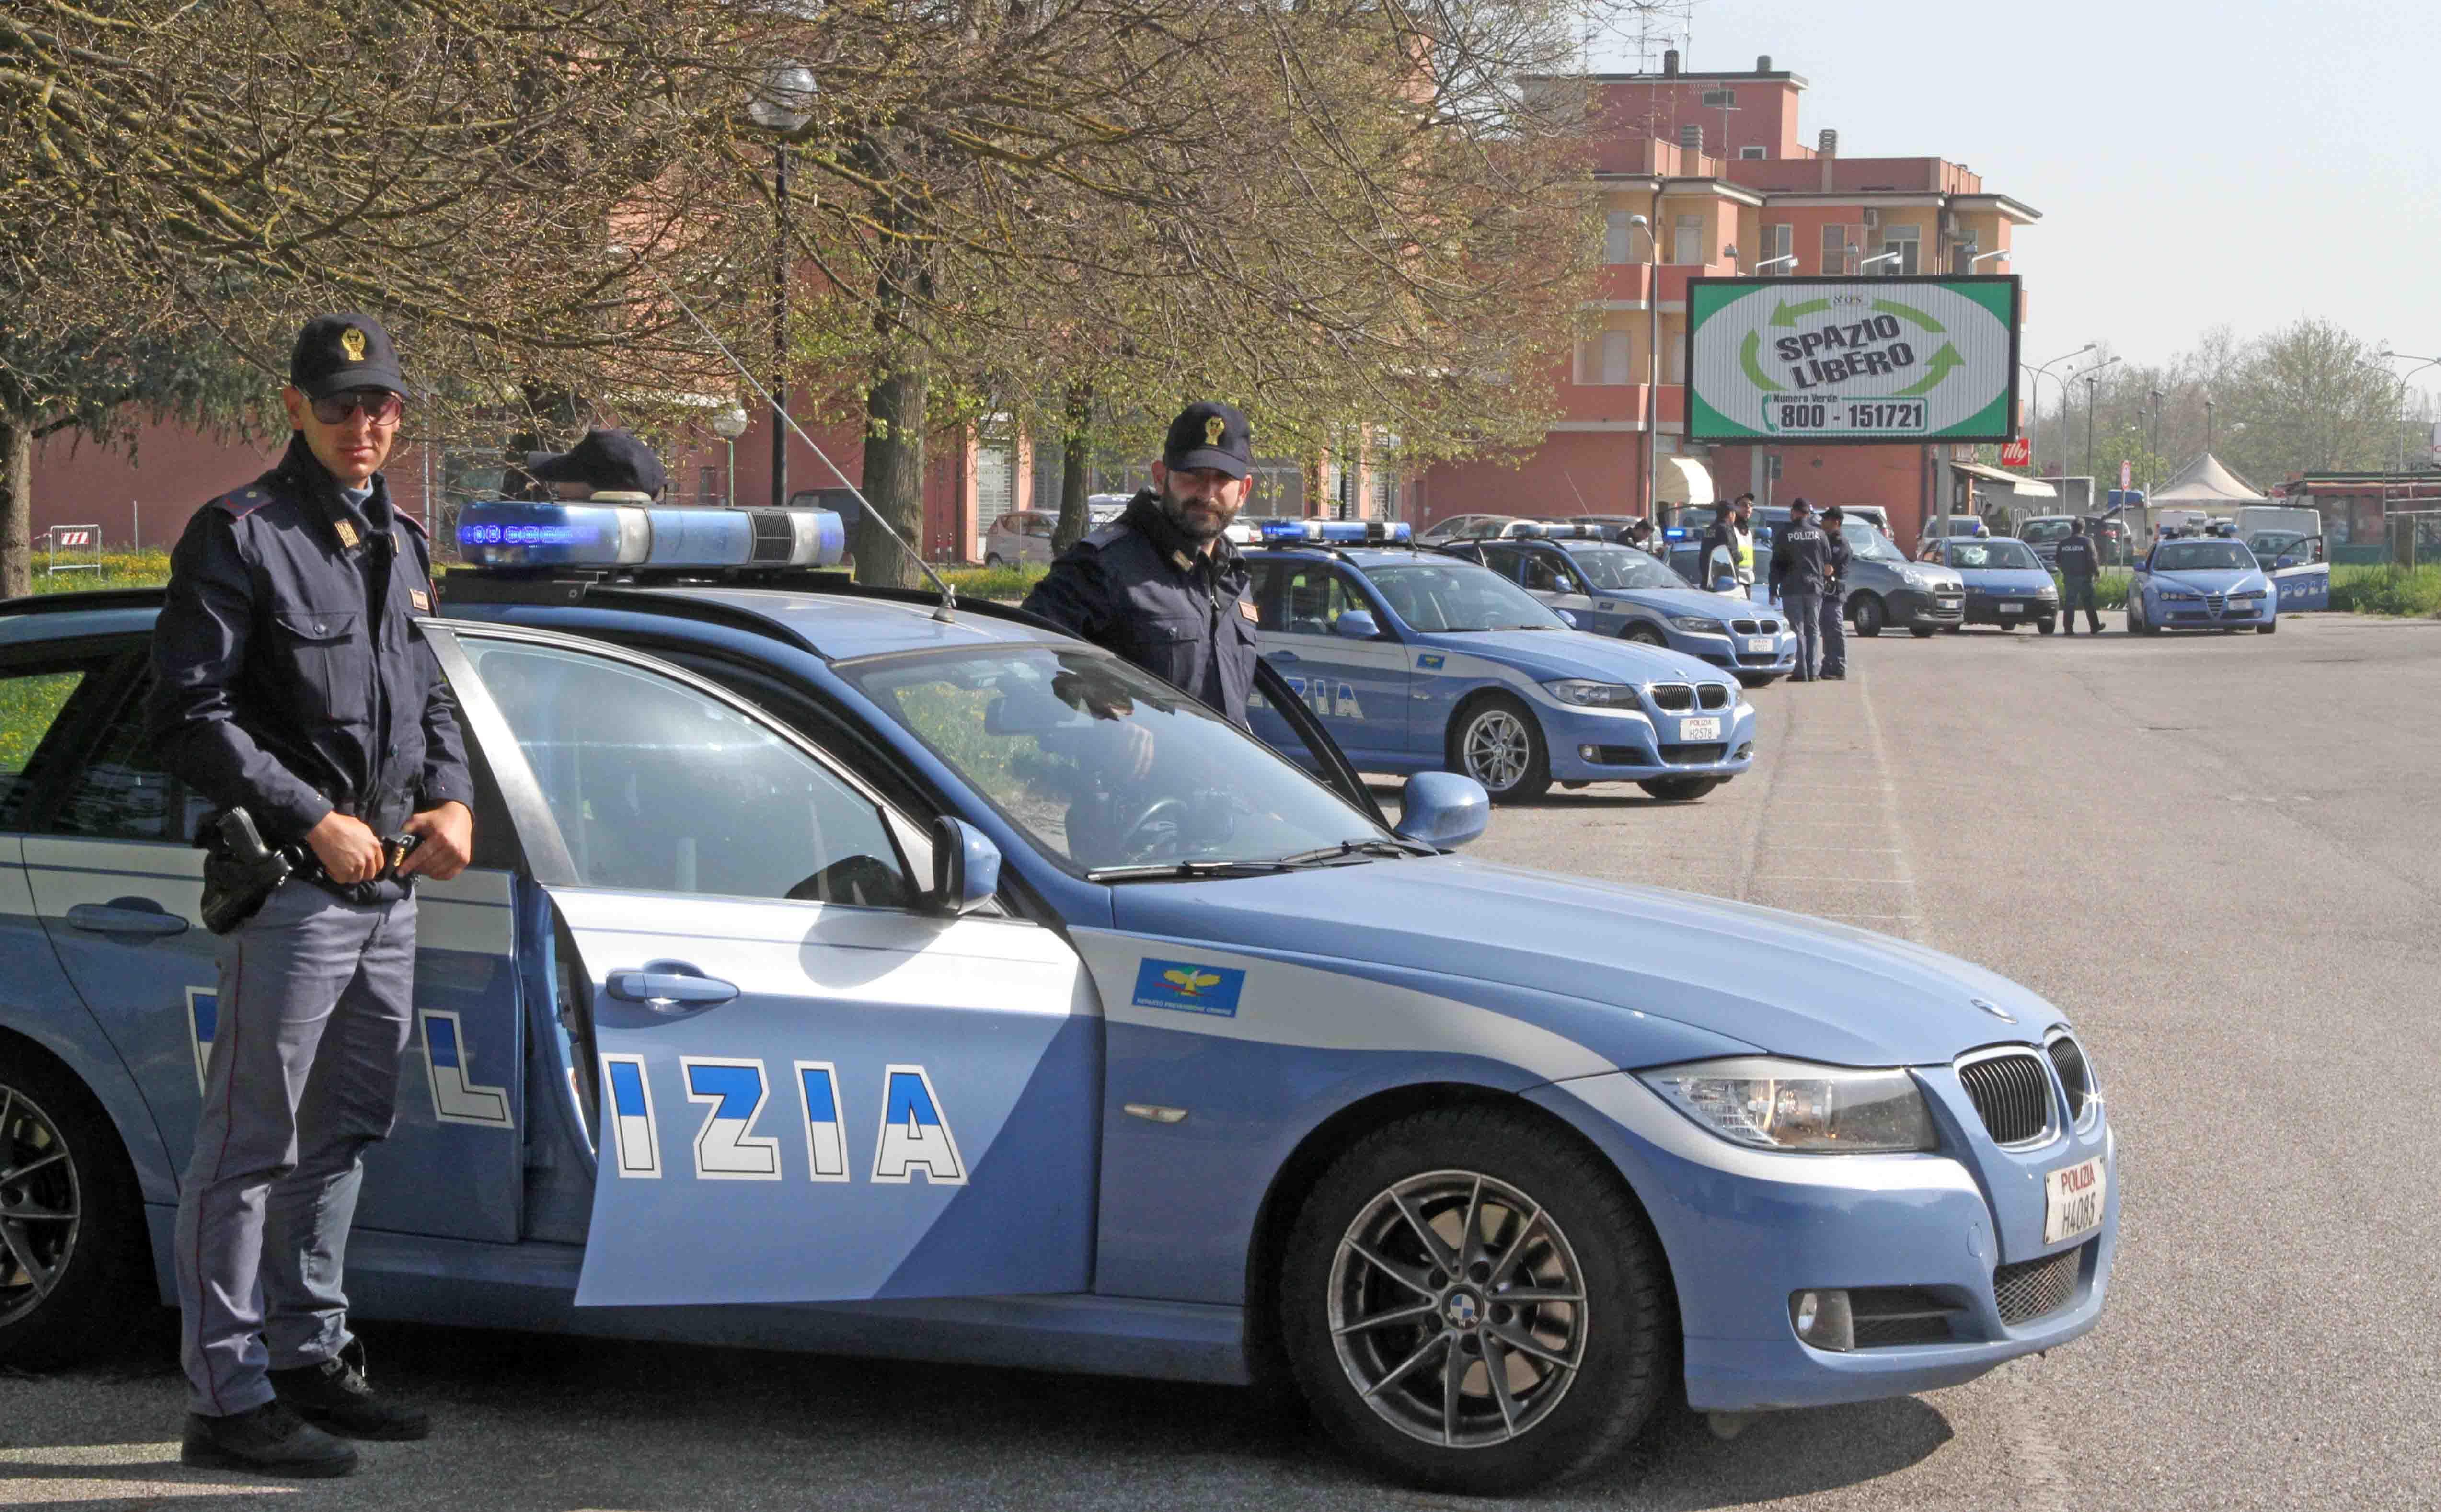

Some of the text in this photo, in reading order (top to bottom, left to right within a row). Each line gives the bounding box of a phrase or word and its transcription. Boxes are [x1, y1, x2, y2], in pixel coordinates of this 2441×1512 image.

[1775, 314, 1900, 362] SPAZIO
[1790, 342, 1915, 389] LIBERO
[1773, 394, 1838, 403] Numero Verde
[1781, 404, 1825, 428] 800
[1848, 404, 1922, 428] 151721
[2003, 442, 2028, 464] illy
[1787, 530, 1821, 542] POLIZIA
[600, 1053, 970, 1186] IZIA
[2061, 1161, 2096, 1195] POLIZIA
